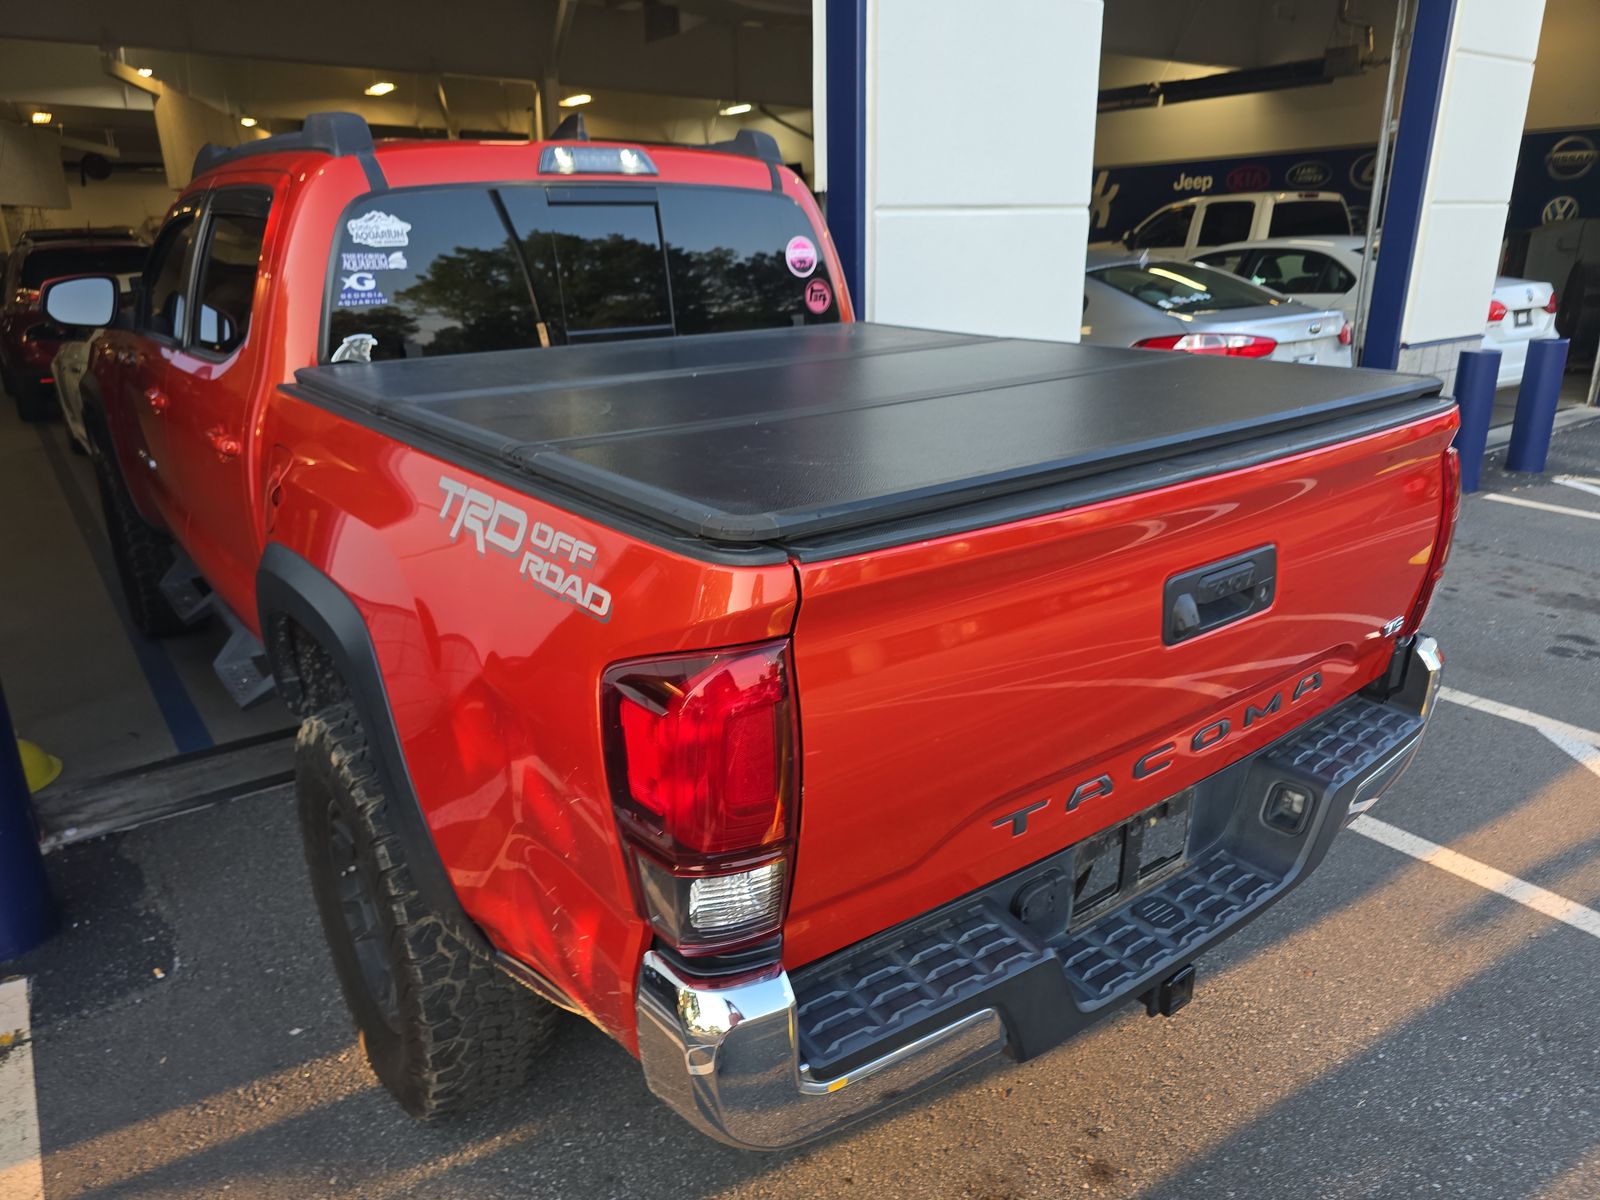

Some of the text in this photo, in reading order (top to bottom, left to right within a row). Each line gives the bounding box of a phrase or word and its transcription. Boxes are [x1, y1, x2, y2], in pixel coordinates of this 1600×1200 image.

[1173, 171, 1213, 192] Jeep
[354, 229, 405, 241] AQUARIUM
[338, 298, 389, 307] AQUARIUM
[340, 291, 384, 300] GEORGIA
[438, 475, 528, 557] TRD
[530, 521, 598, 568] OFF
[519, 551, 613, 621] ROAD
[991, 671, 1323, 838] TACOMA
